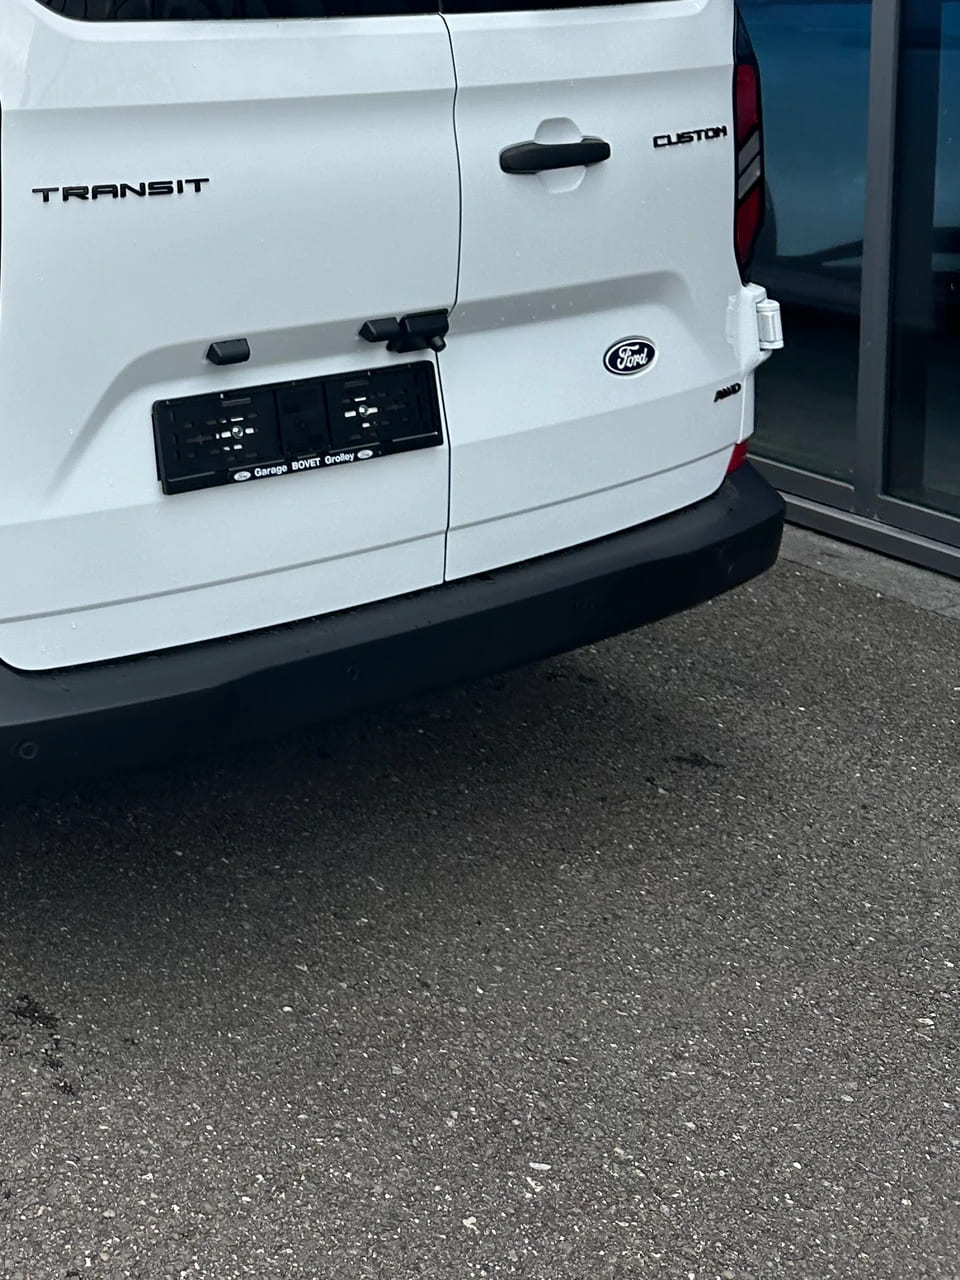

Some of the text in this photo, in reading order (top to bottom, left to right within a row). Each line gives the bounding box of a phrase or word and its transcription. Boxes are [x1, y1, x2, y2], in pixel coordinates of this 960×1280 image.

[653, 125, 728, 148] CUSTOM
[31, 178, 210, 202] TRANSIT
[616, 344, 649, 369] Ford
[253, 464, 288, 478] Garage
[291, 457, 321, 470] BOVET
